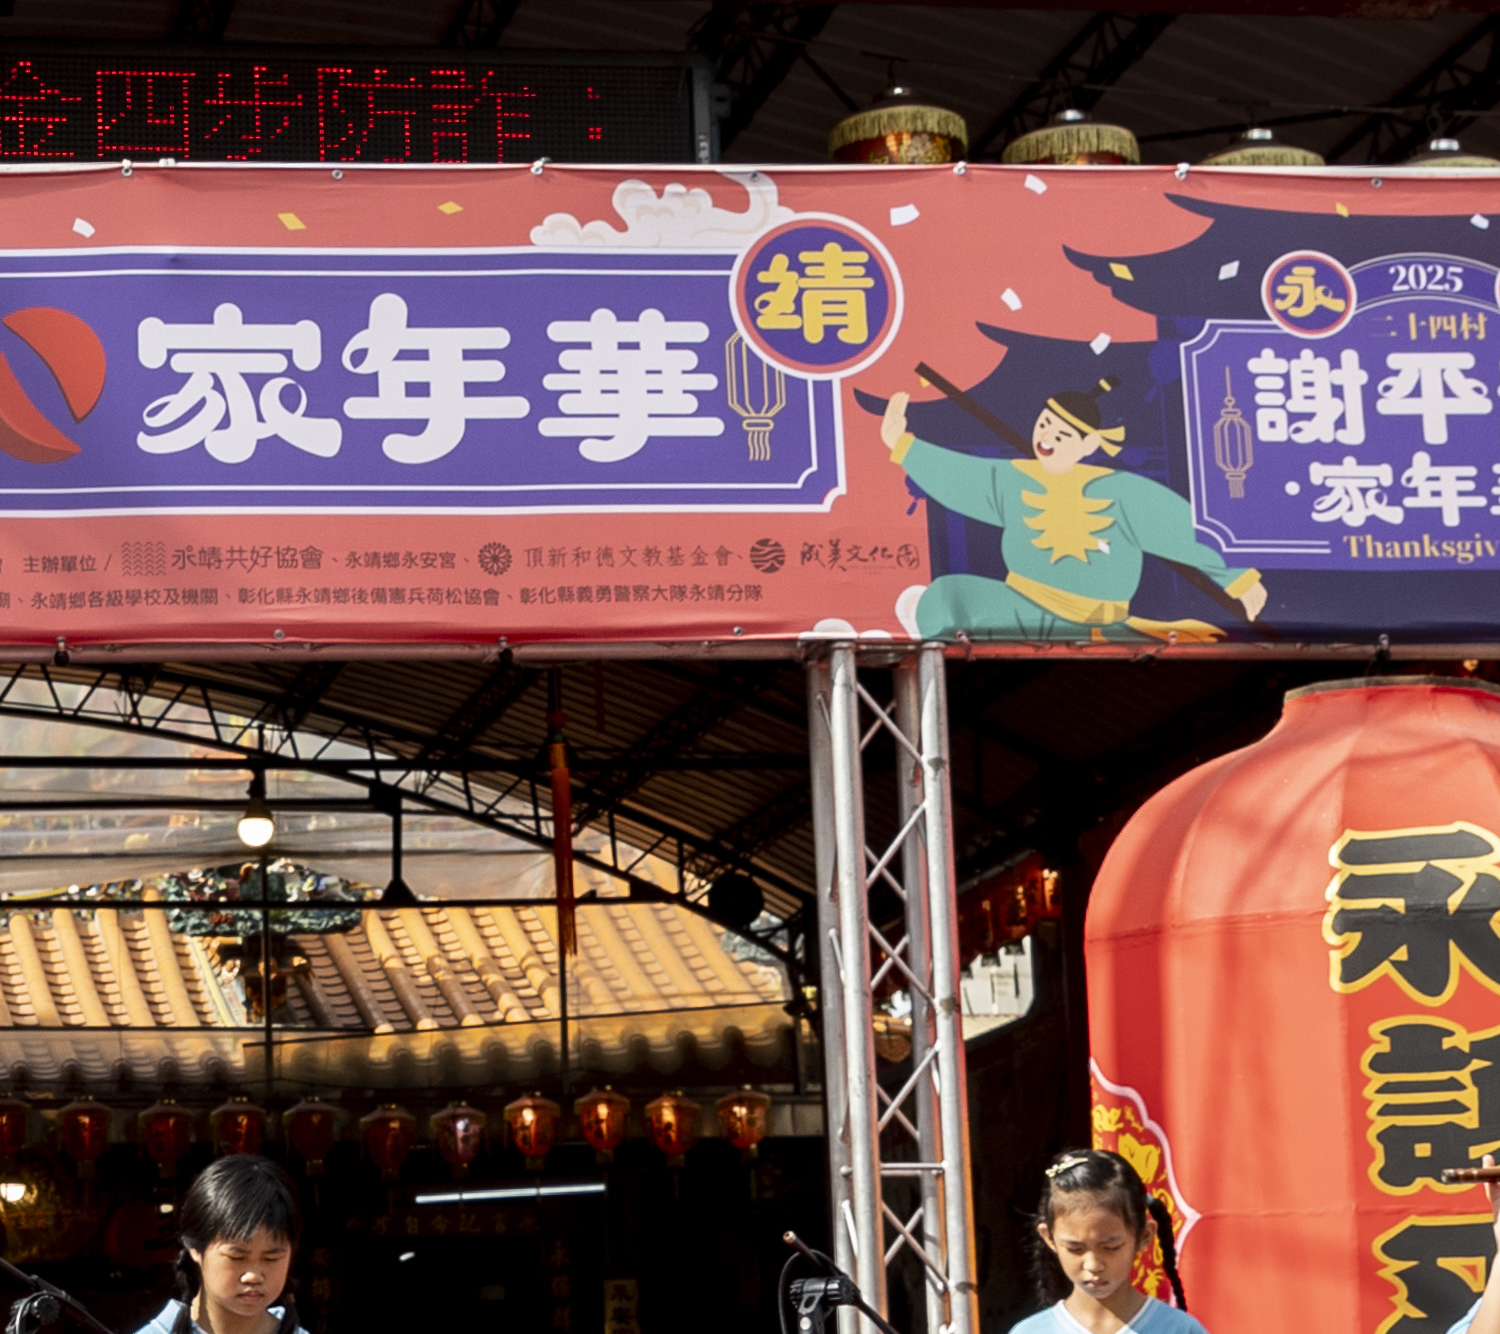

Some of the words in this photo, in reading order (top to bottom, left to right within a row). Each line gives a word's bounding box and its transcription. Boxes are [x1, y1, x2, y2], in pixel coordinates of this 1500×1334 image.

[753, 241, 876, 345] 靖
[1274, 265, 1347, 319] 永
[1389, 262, 1464, 293] 2025
[1368, 311, 1488, 343] 二十四村
[136, 292, 726, 465] 家年華
[22, 555, 98, 574] 主辦單位
